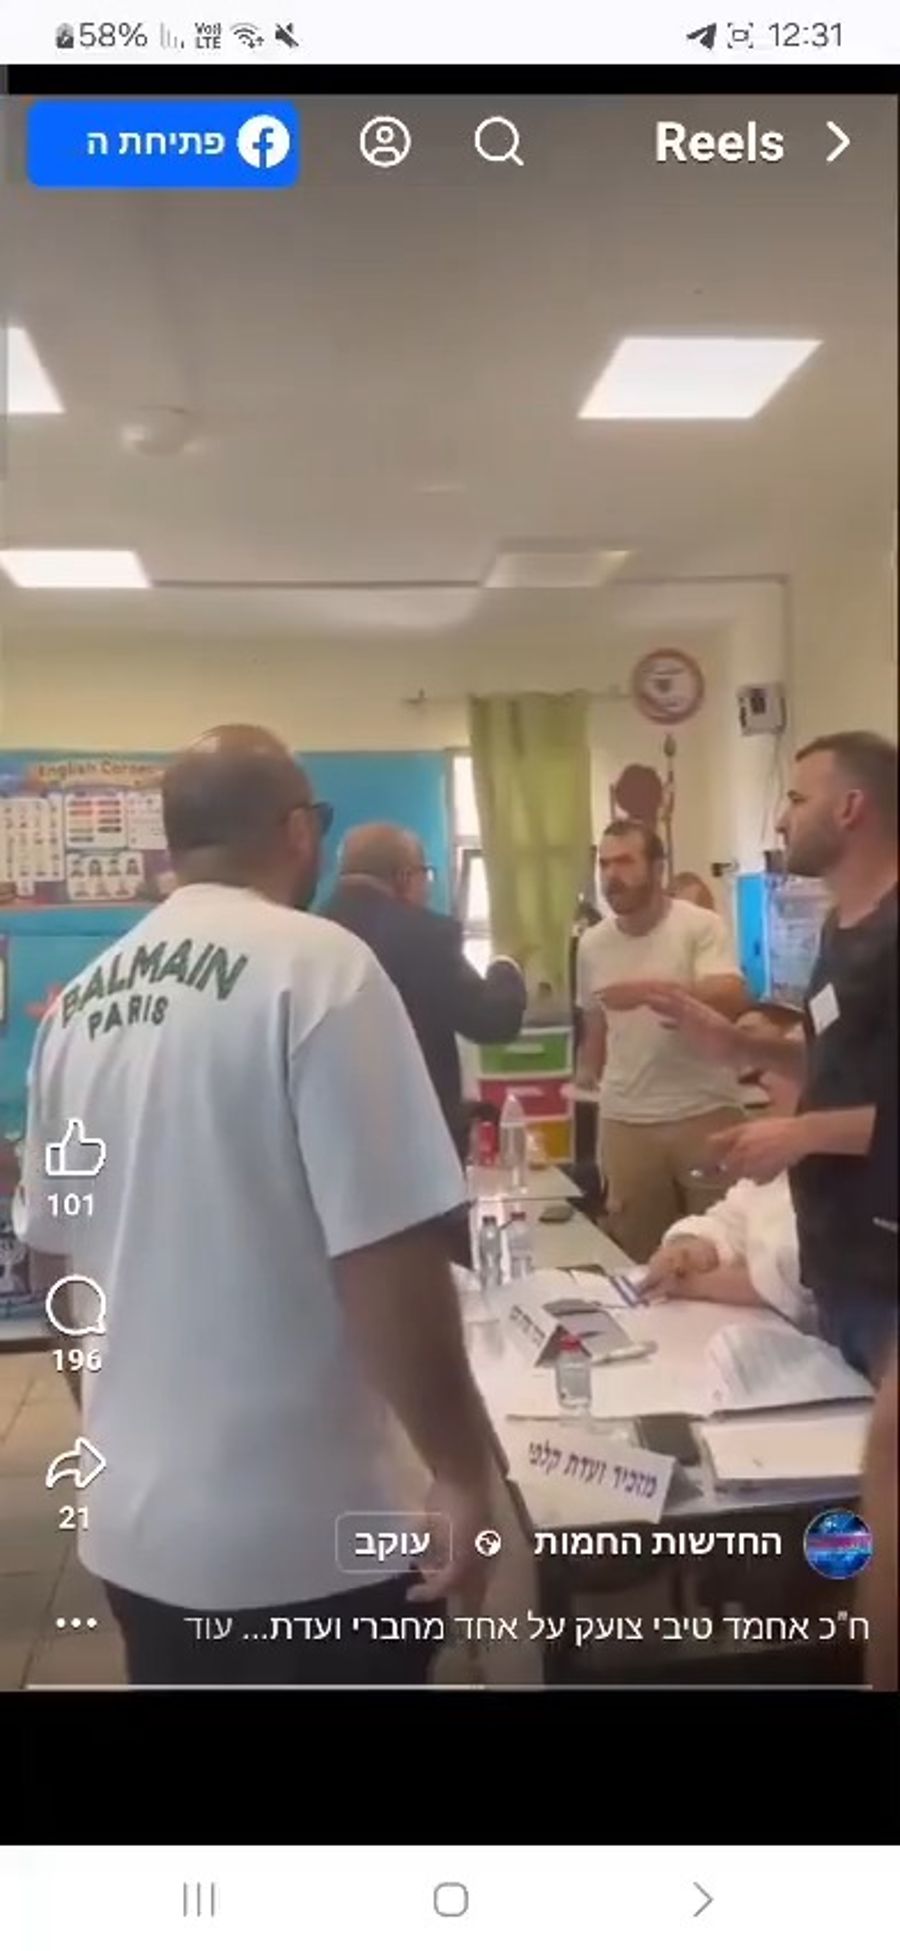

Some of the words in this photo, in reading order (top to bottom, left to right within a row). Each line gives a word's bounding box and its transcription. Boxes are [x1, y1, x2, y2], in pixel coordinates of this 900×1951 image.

[38, 759, 98, 779] English
[60, 938, 248, 1028] BALMAIN
[87, 995, 169, 1041] PARIS
[529, 1440, 563, 1475] קלפי
[564, 1453, 607, 1484] ועדת
[614, 1465, 658, 1498] מזכיר
